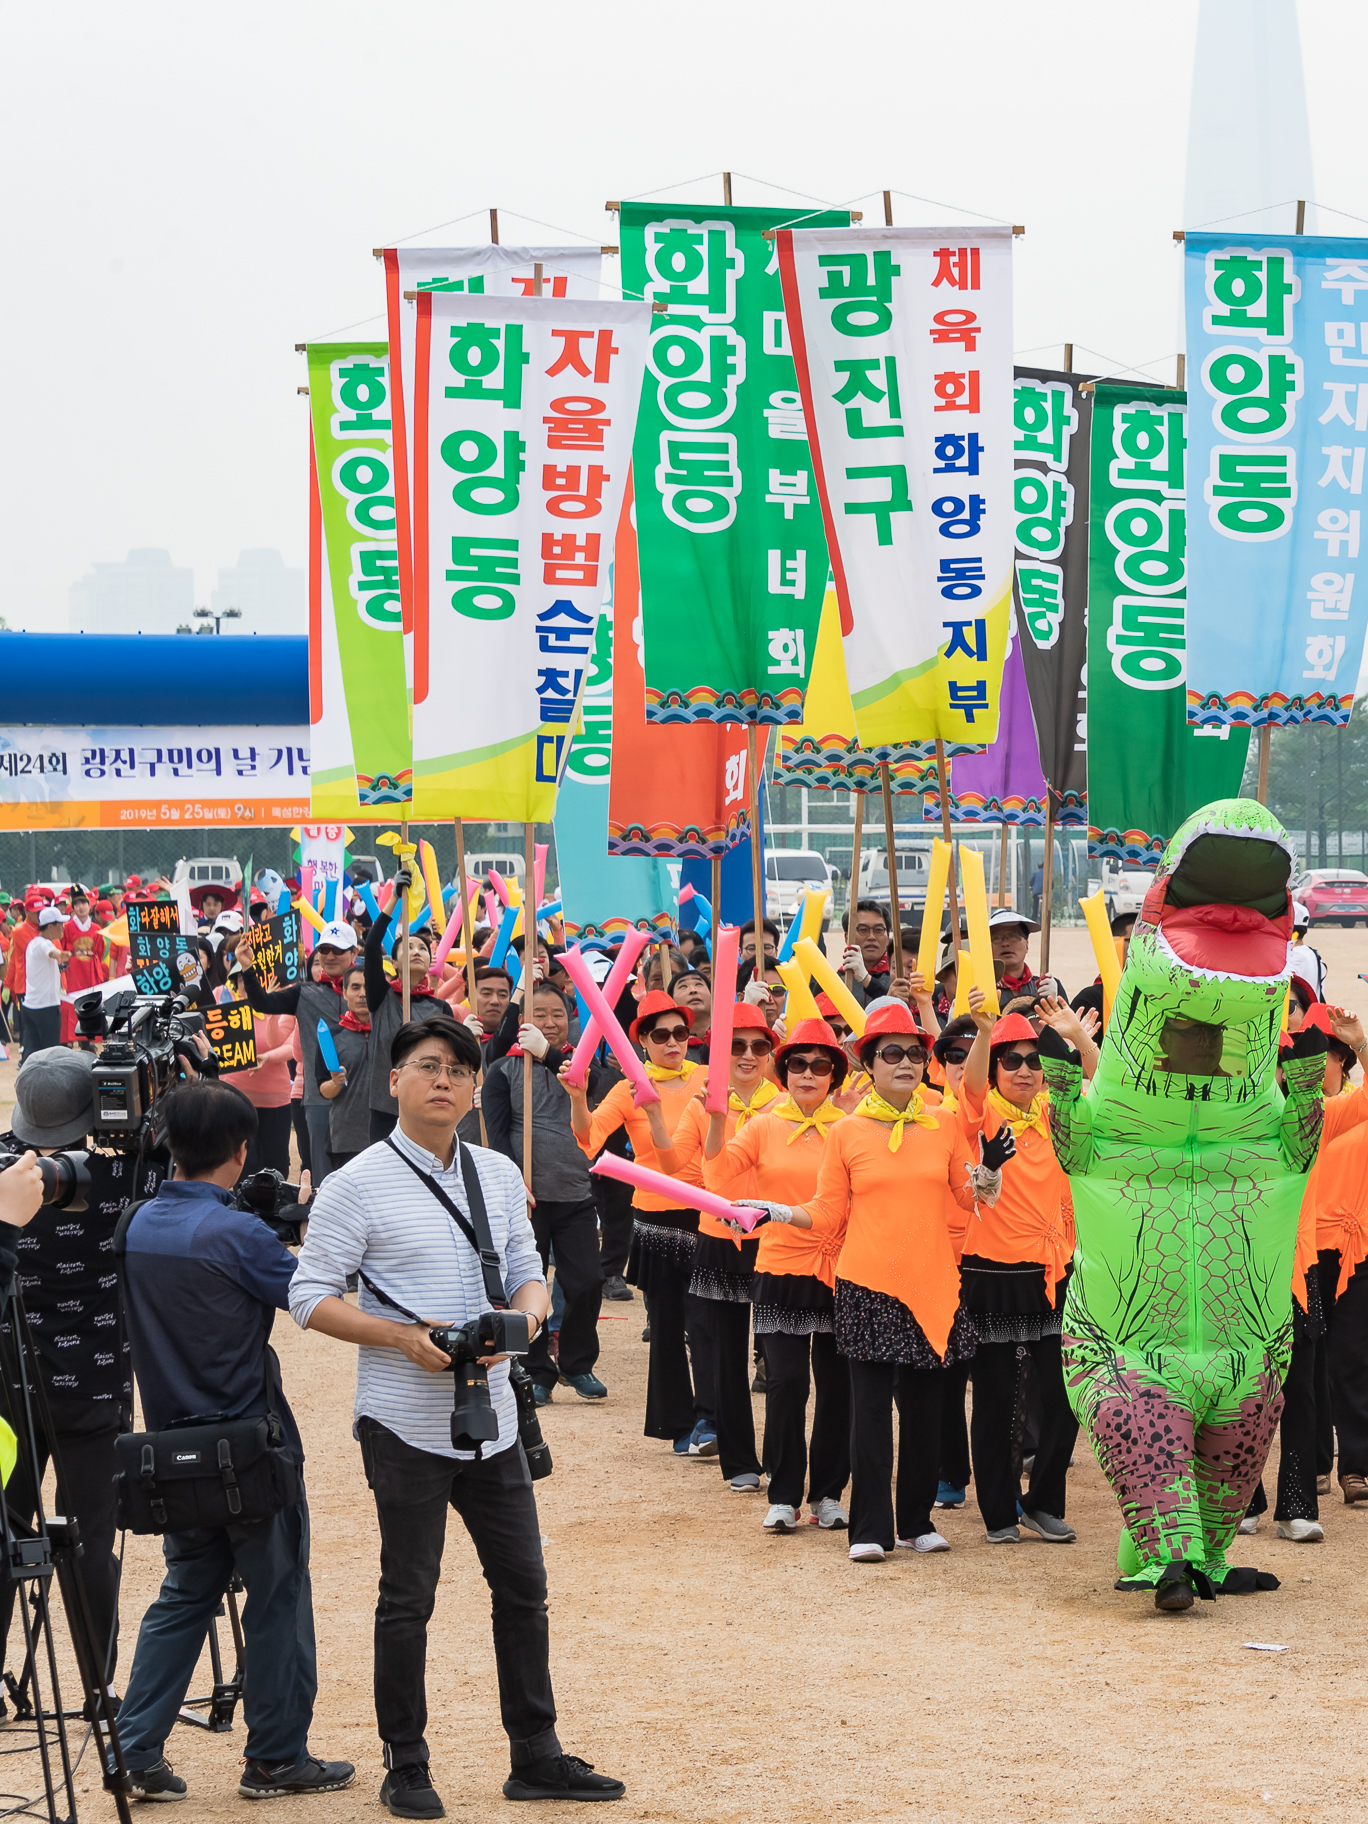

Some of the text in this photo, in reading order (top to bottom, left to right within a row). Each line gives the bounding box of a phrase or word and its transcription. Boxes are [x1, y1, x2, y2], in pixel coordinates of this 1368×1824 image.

[441, 322, 530, 621] 화양동
[653, 227, 738, 524] 화양동
[762, 240, 811, 678] 을부녀회
[817, 250, 914, 546] 광진구
[1013, 385, 1072, 642] 화양동
[1208, 255, 1296, 534] 화양동
[1115, 409, 1187, 682] 화양동
[0, 751, 68, 777] 제24회
[81, 746, 223, 779] 광진구민의
[232, 746, 261, 777] 날
[120, 808, 157, 820] 2019년
[160, 804, 181, 820] 5월
[568, 613, 613, 777] 양동
